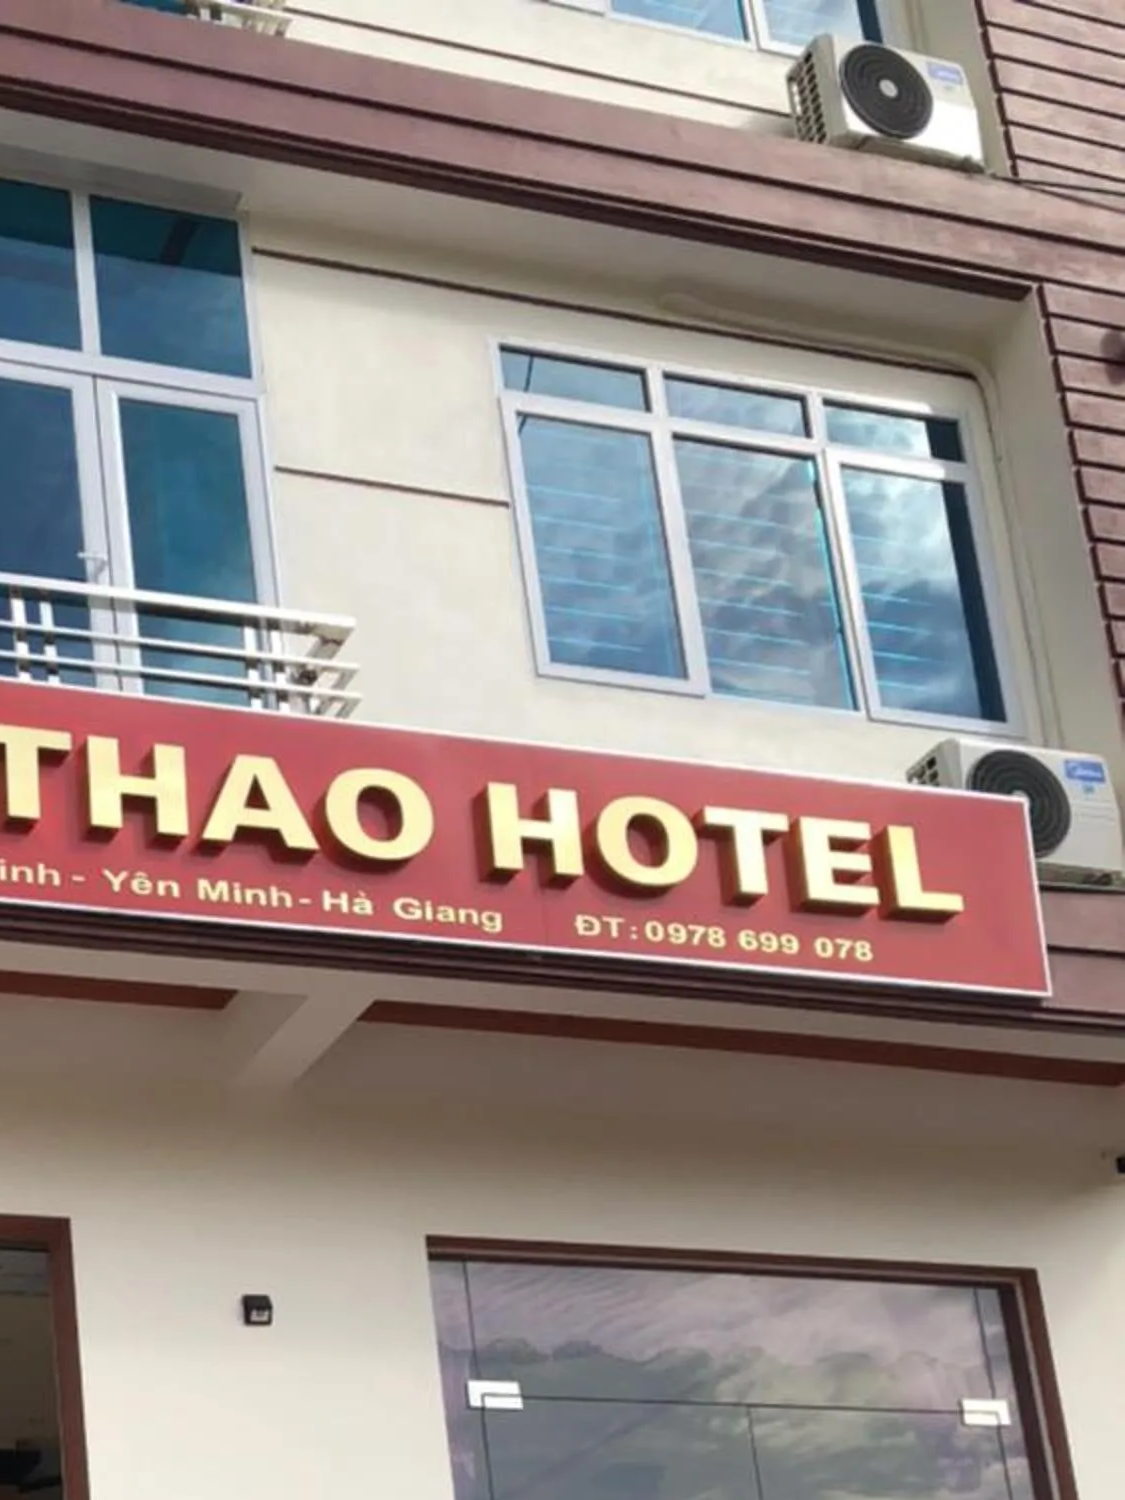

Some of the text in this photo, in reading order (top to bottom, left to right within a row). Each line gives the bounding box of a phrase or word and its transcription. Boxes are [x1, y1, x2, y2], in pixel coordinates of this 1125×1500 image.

[486, 781, 964, 915] HOTEL
[103, 868, 179, 900] Yên
[197, 878, 293, 909] Minh
[321, 890, 375, 917] Hà
[393, 896, 503, 934] Giang
[738, 929, 800, 954] 699
[813, 936, 875, 962] 078
